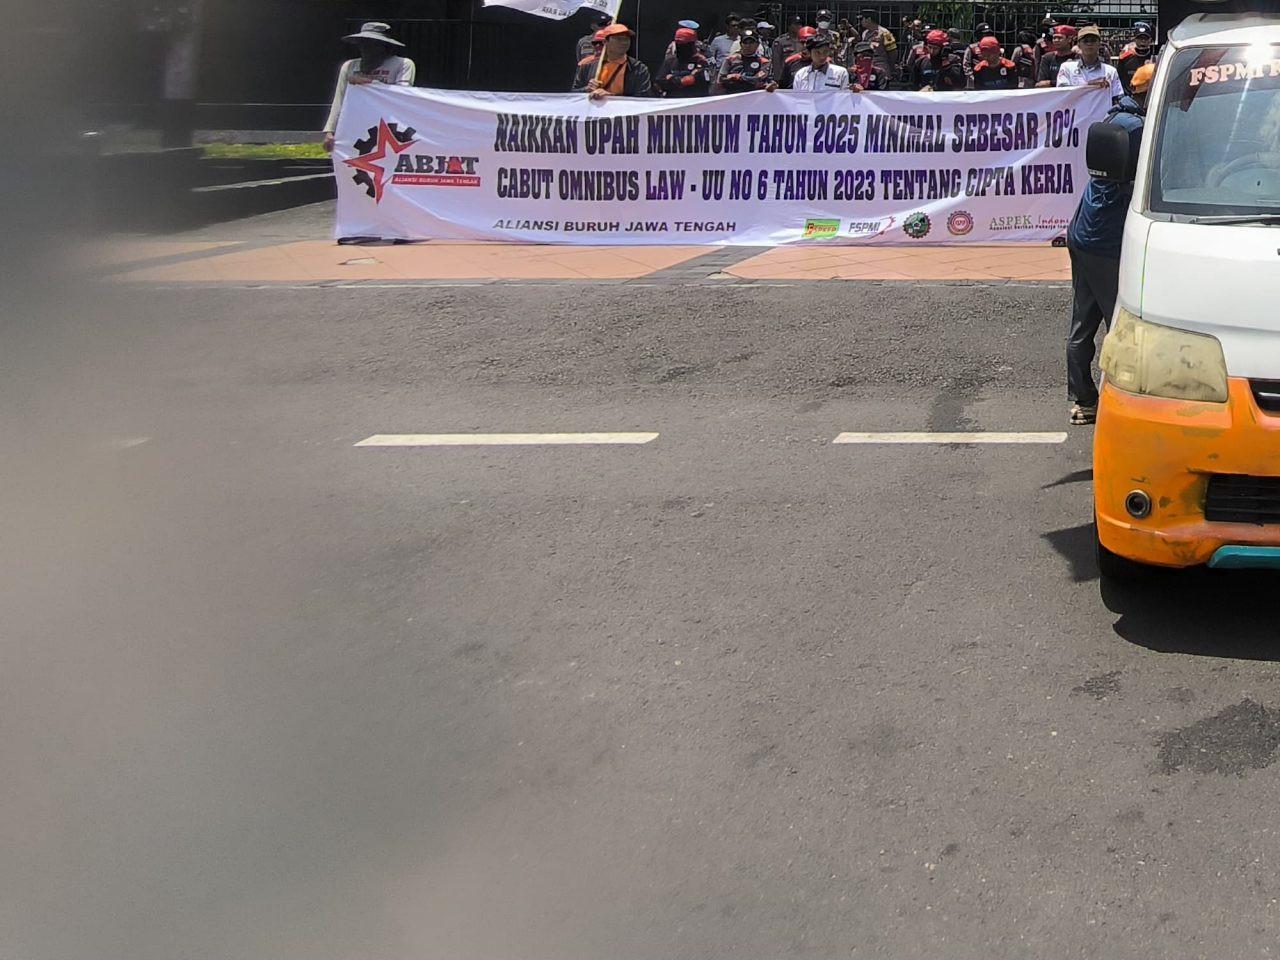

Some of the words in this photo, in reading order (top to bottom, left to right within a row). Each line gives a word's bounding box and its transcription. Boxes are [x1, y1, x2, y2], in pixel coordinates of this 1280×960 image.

[1189, 62, 1264, 86] FSPMI
[494, 113, 578, 154] NAIKKAN
[584, 116, 640, 155] UPAH
[646, 114, 740, 155] MINIMUM
[747, 113, 809, 154] TAHUN
[813, 113, 859, 154] 2025
[864, 114, 945, 153] MINIMAL
[951, 112, 1039, 152] SEBESAR
[1044, 108, 1079, 149] 10%
[497, 167, 554, 200] CABUT
[559, 169, 640, 201] OMNIBUS
[645, 170, 685, 200] LAW
[702, 170, 727, 201] UU
[730, 169, 752, 200] NO
[758, 170, 767, 201] 6
[773, 169, 828, 200] TAHUN
[833, 169, 875, 200] 2023
[881, 168, 961, 200] TENTANG
[965, 166, 1015, 197] CIPTA
[1020, 163, 1074, 196] KERJA
[493, 219, 559, 231] ALIANSI
[564, 221, 620, 233] BURUH
[624, 221, 668, 233] JAWA
[674, 221, 736, 233] TENGAH
[990, 215, 1032, 227] ASPEK
